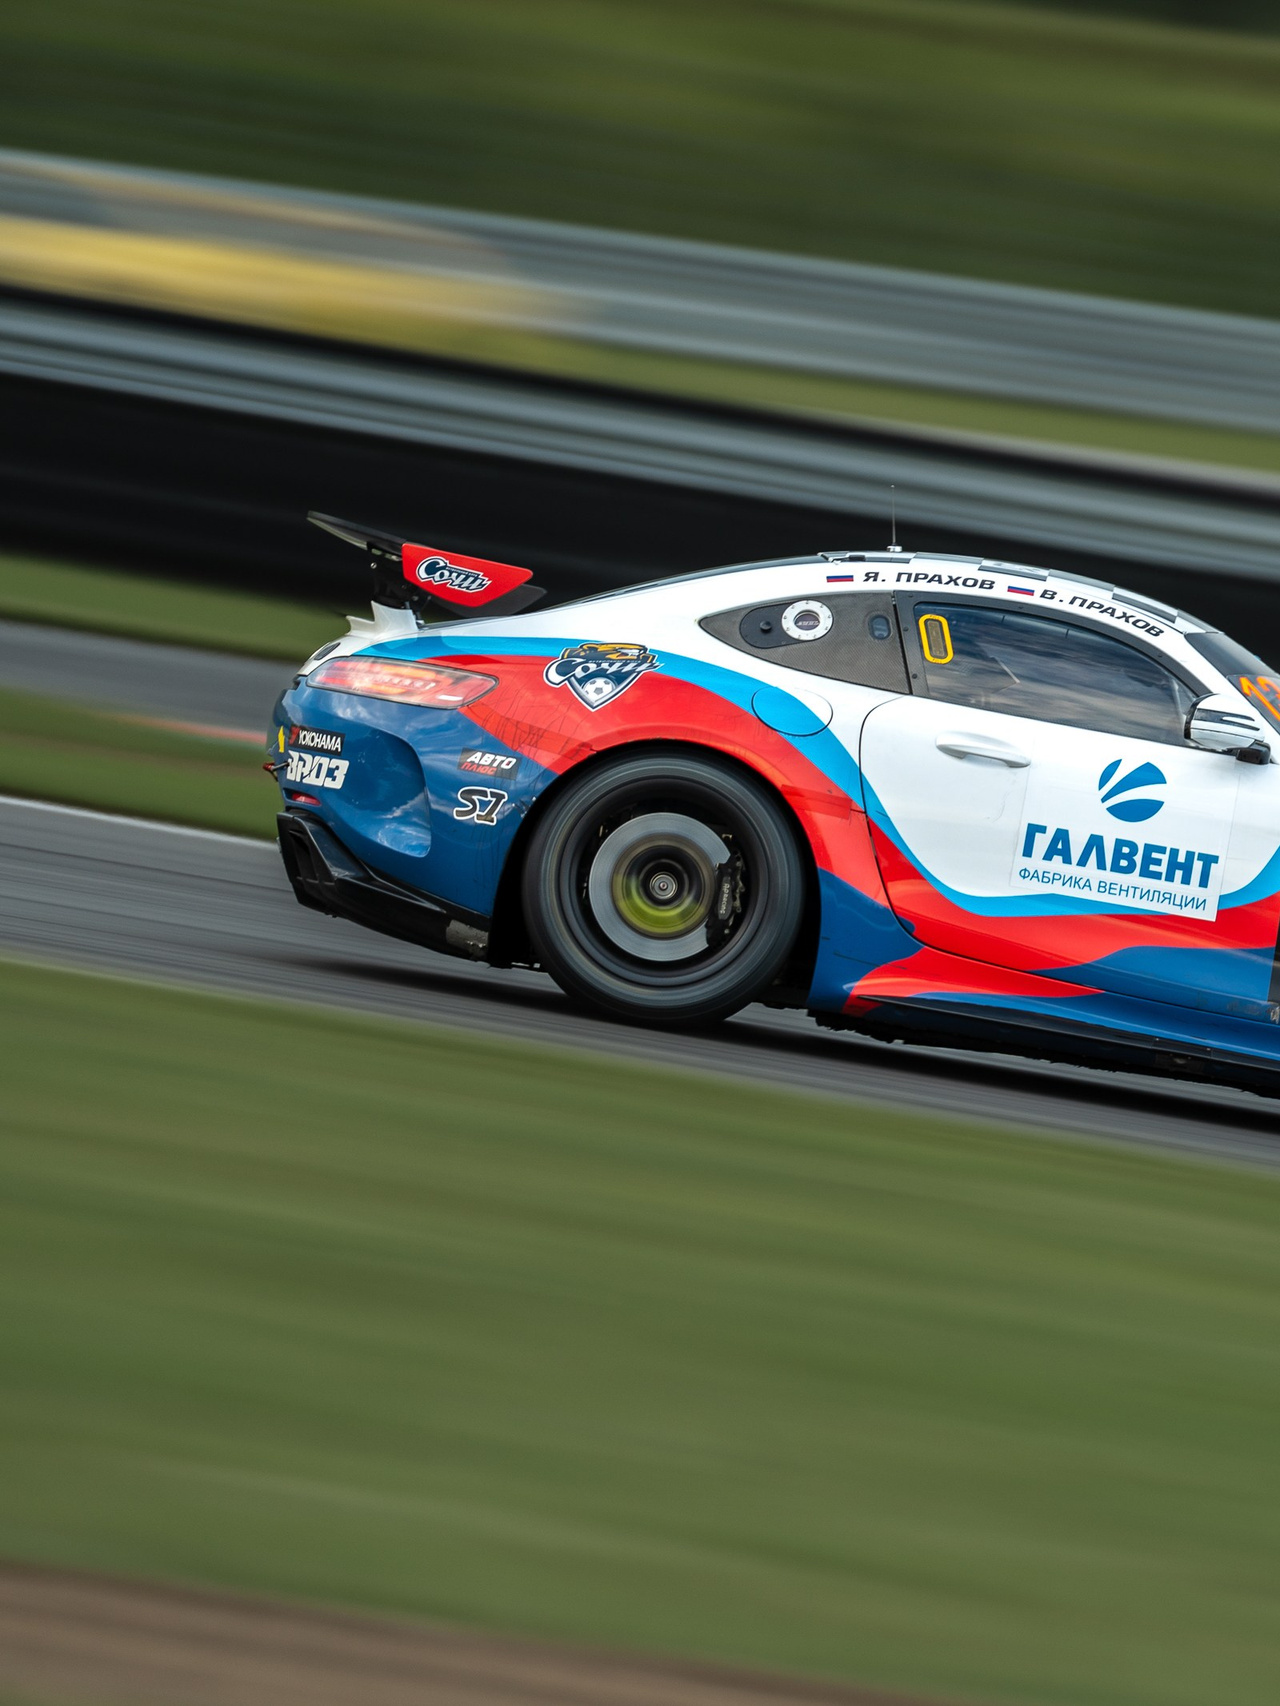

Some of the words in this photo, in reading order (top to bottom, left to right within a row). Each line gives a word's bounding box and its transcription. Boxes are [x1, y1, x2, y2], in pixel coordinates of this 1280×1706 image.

[862, 571, 887, 583] Я.
[895, 572, 996, 590] ПРАХОВ
[1039, 589, 1064, 603] В.
[1068, 595, 1165, 637] ПРАХОВ
[298, 729, 342, 753] YOKOHAMA
[460, 762, 498, 776] ПЛЮС
[466, 751, 518, 770] АВТО
[1022, 822, 1220, 889] ГАЛВЕНТ
[1018, 867, 1093, 892] ФАБРИКА
[1096, 880, 1208, 912] ВЕНТИЛЯЦИИ
